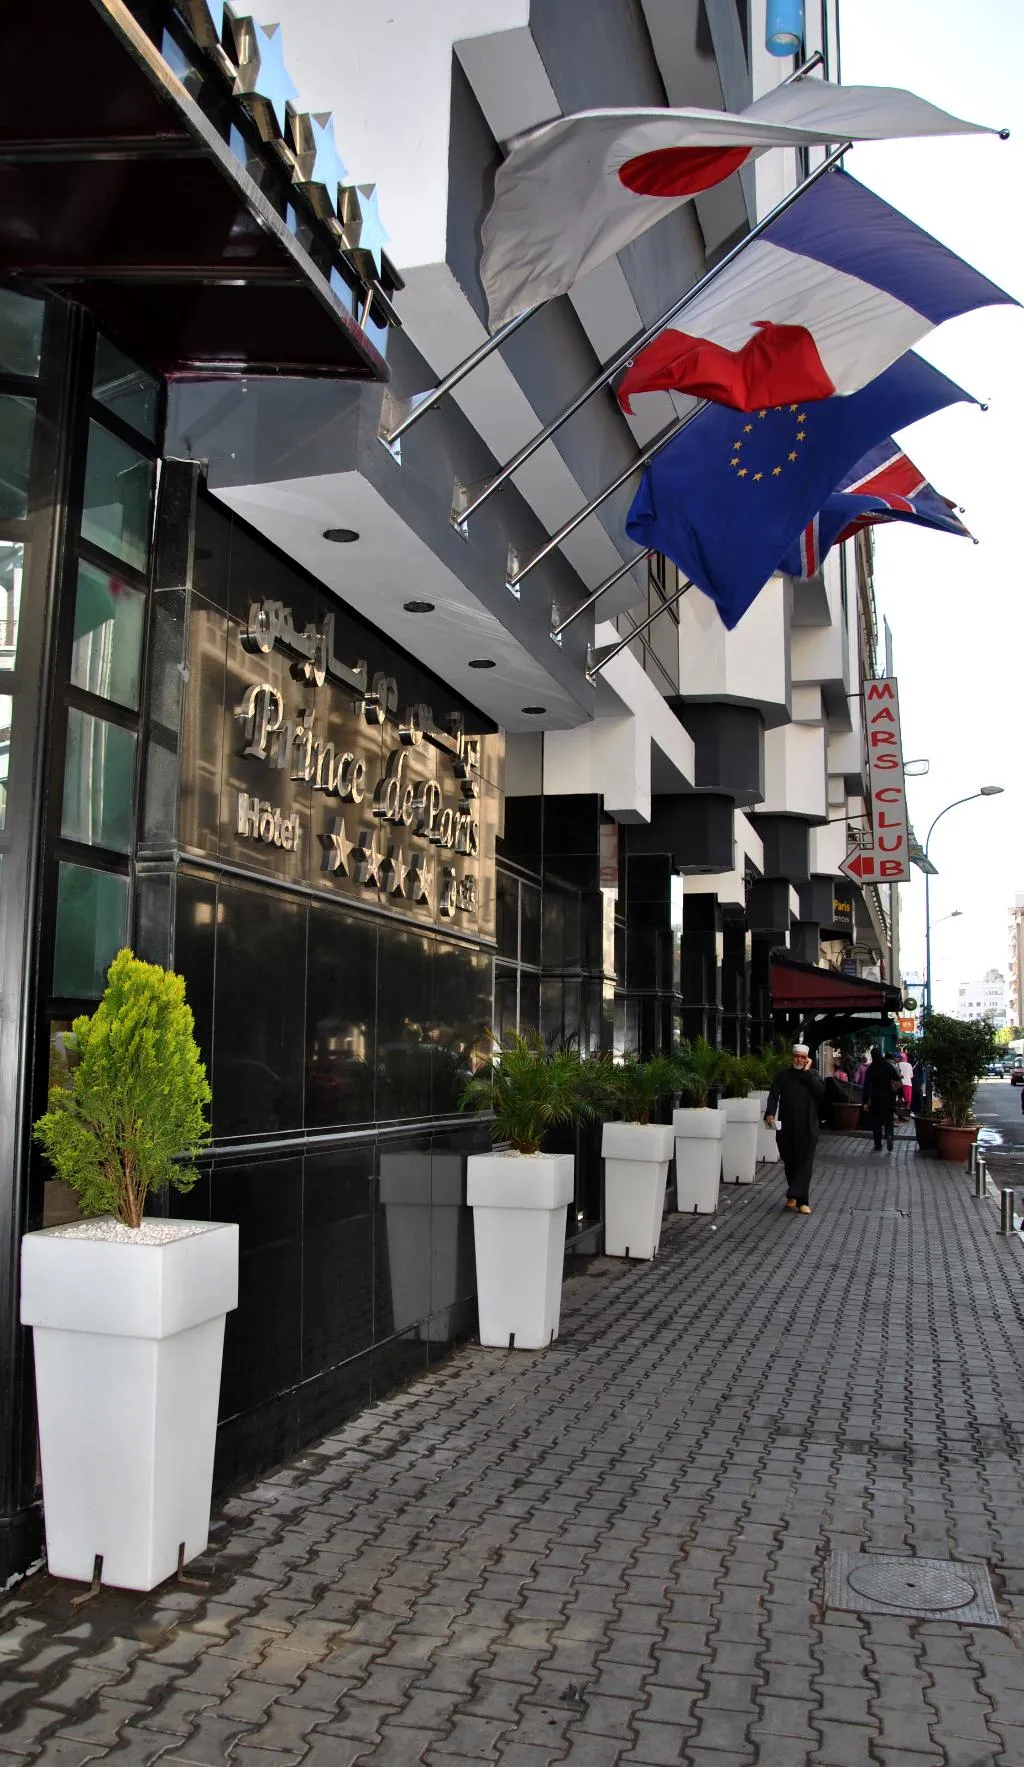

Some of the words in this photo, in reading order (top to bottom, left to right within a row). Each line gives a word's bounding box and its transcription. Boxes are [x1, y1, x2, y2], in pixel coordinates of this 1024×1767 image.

[234, 684, 367, 804] Prince
[373, 748, 414, 826] de
[411, 780, 480, 857] Paris
[867, 683, 899, 770] MARS
[238, 792, 300, 852] Hôtel
[874, 788, 904, 877] CLUB
